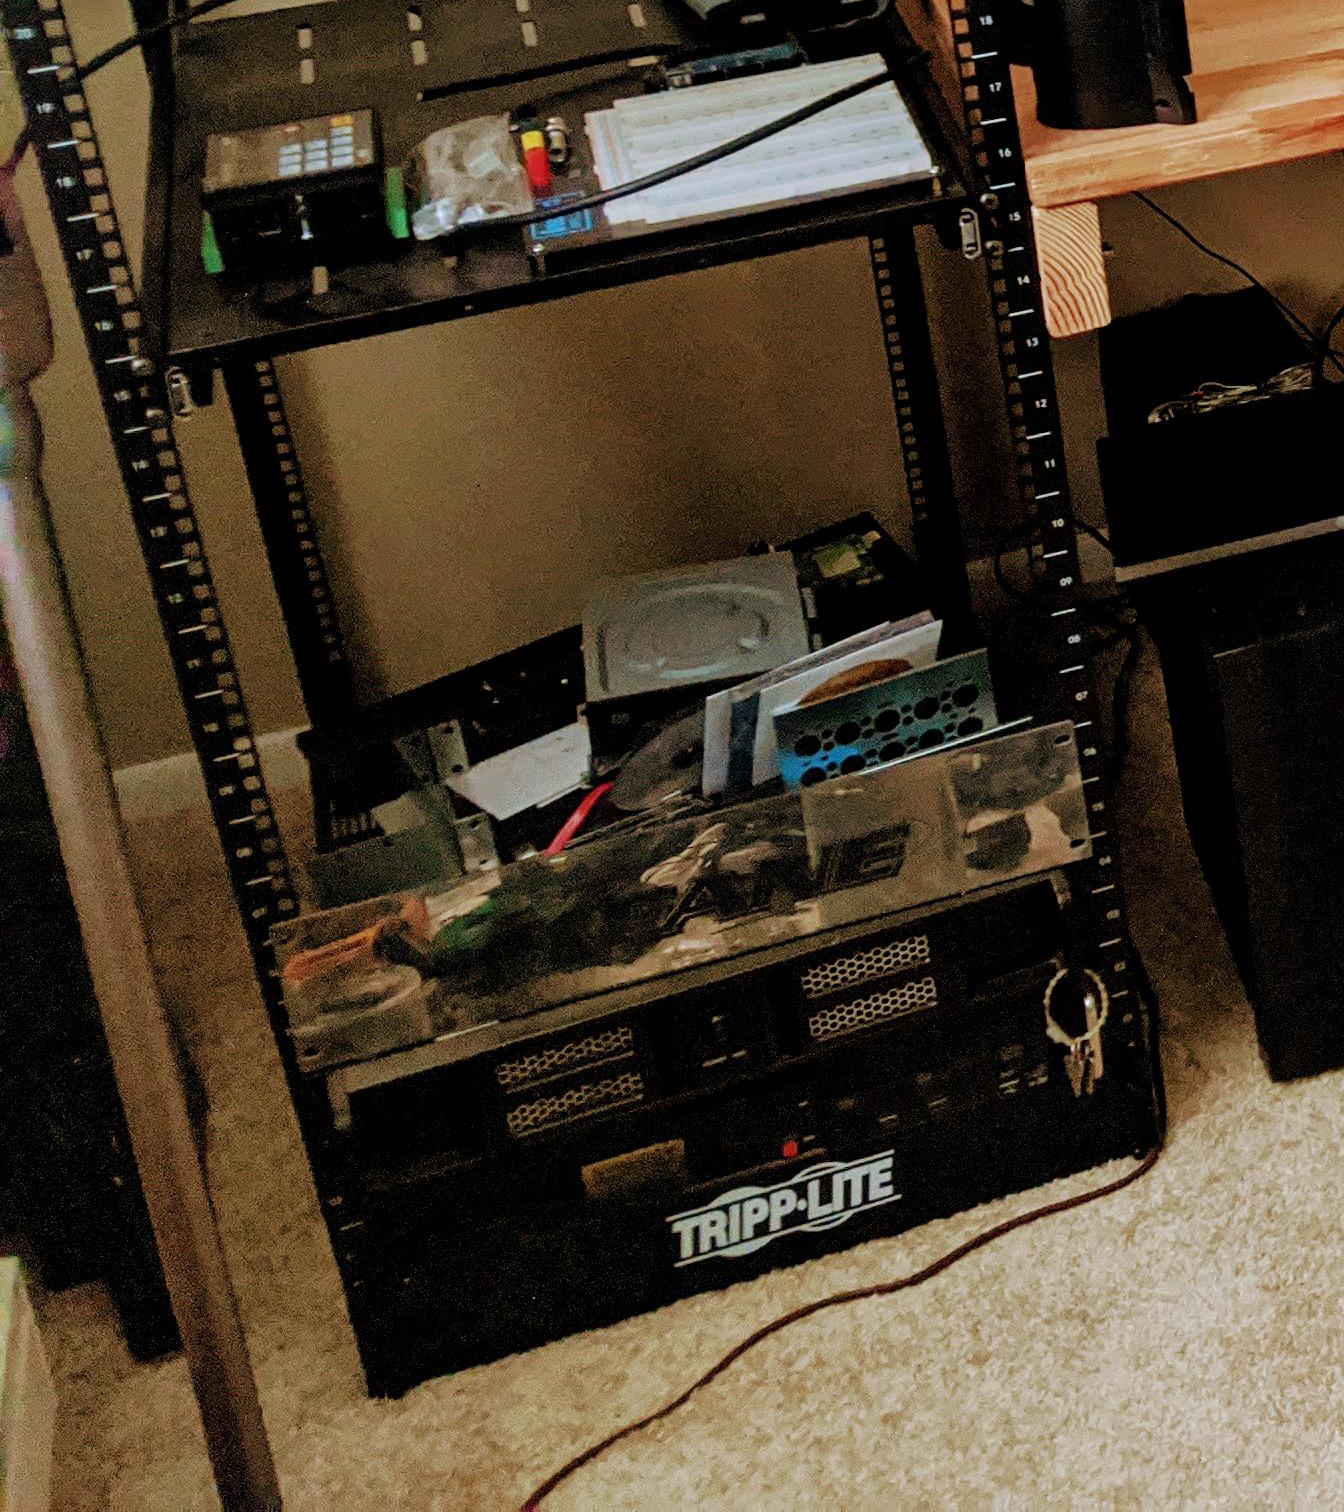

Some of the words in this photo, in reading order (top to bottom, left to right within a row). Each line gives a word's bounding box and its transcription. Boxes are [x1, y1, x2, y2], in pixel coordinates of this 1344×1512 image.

[979, 15, 994, 26] 18
[989, 81, 1002, 93] 17
[998, 147, 1012, 158] 16
[1008, 211, 1021, 222] 15
[1017, 275, 1031, 286] 14
[1025, 337, 1039, 348] 13
[1035, 398, 1048, 409] 12
[1044, 458, 1056, 469] 11
[1051, 518, 1065, 528] 10
[1059, 576, 1073, 587] 09
[1075, 690, 1089, 701] 07
